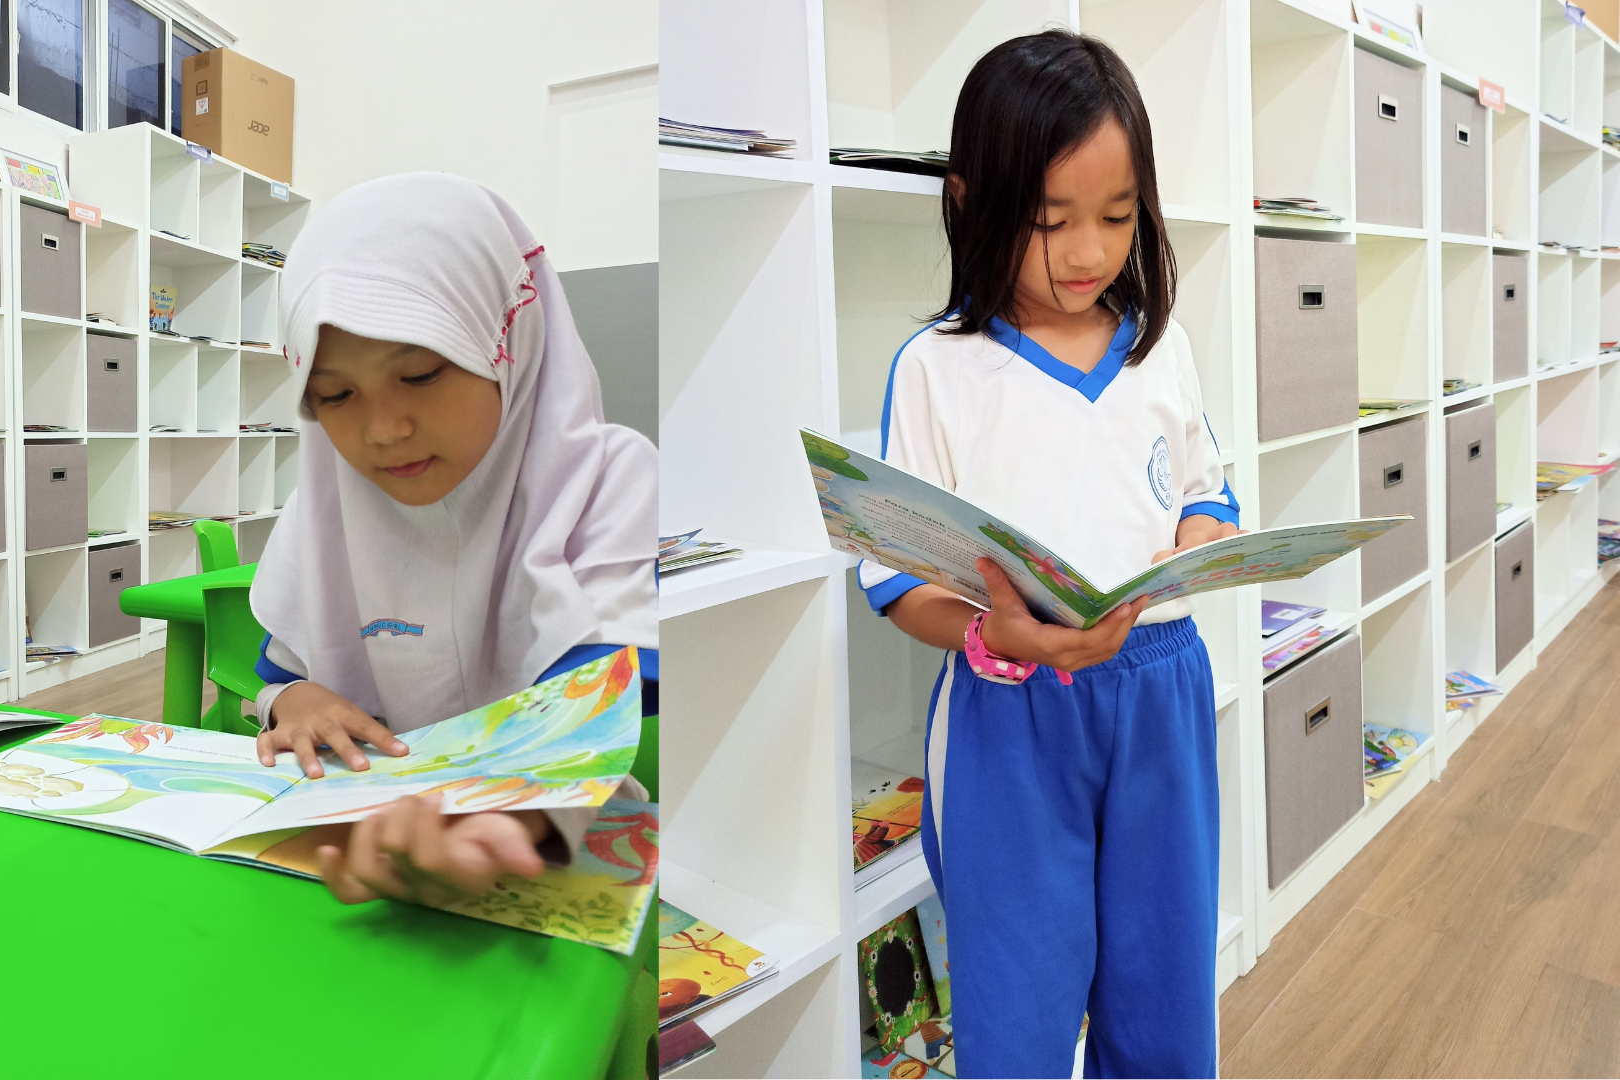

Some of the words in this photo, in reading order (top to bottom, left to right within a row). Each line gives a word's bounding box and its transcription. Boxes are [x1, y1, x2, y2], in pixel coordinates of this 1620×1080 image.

[247, 120, 270, 137] acer
[884, 498, 908, 512] Para
[387, 622, 401, 630] GIRL
